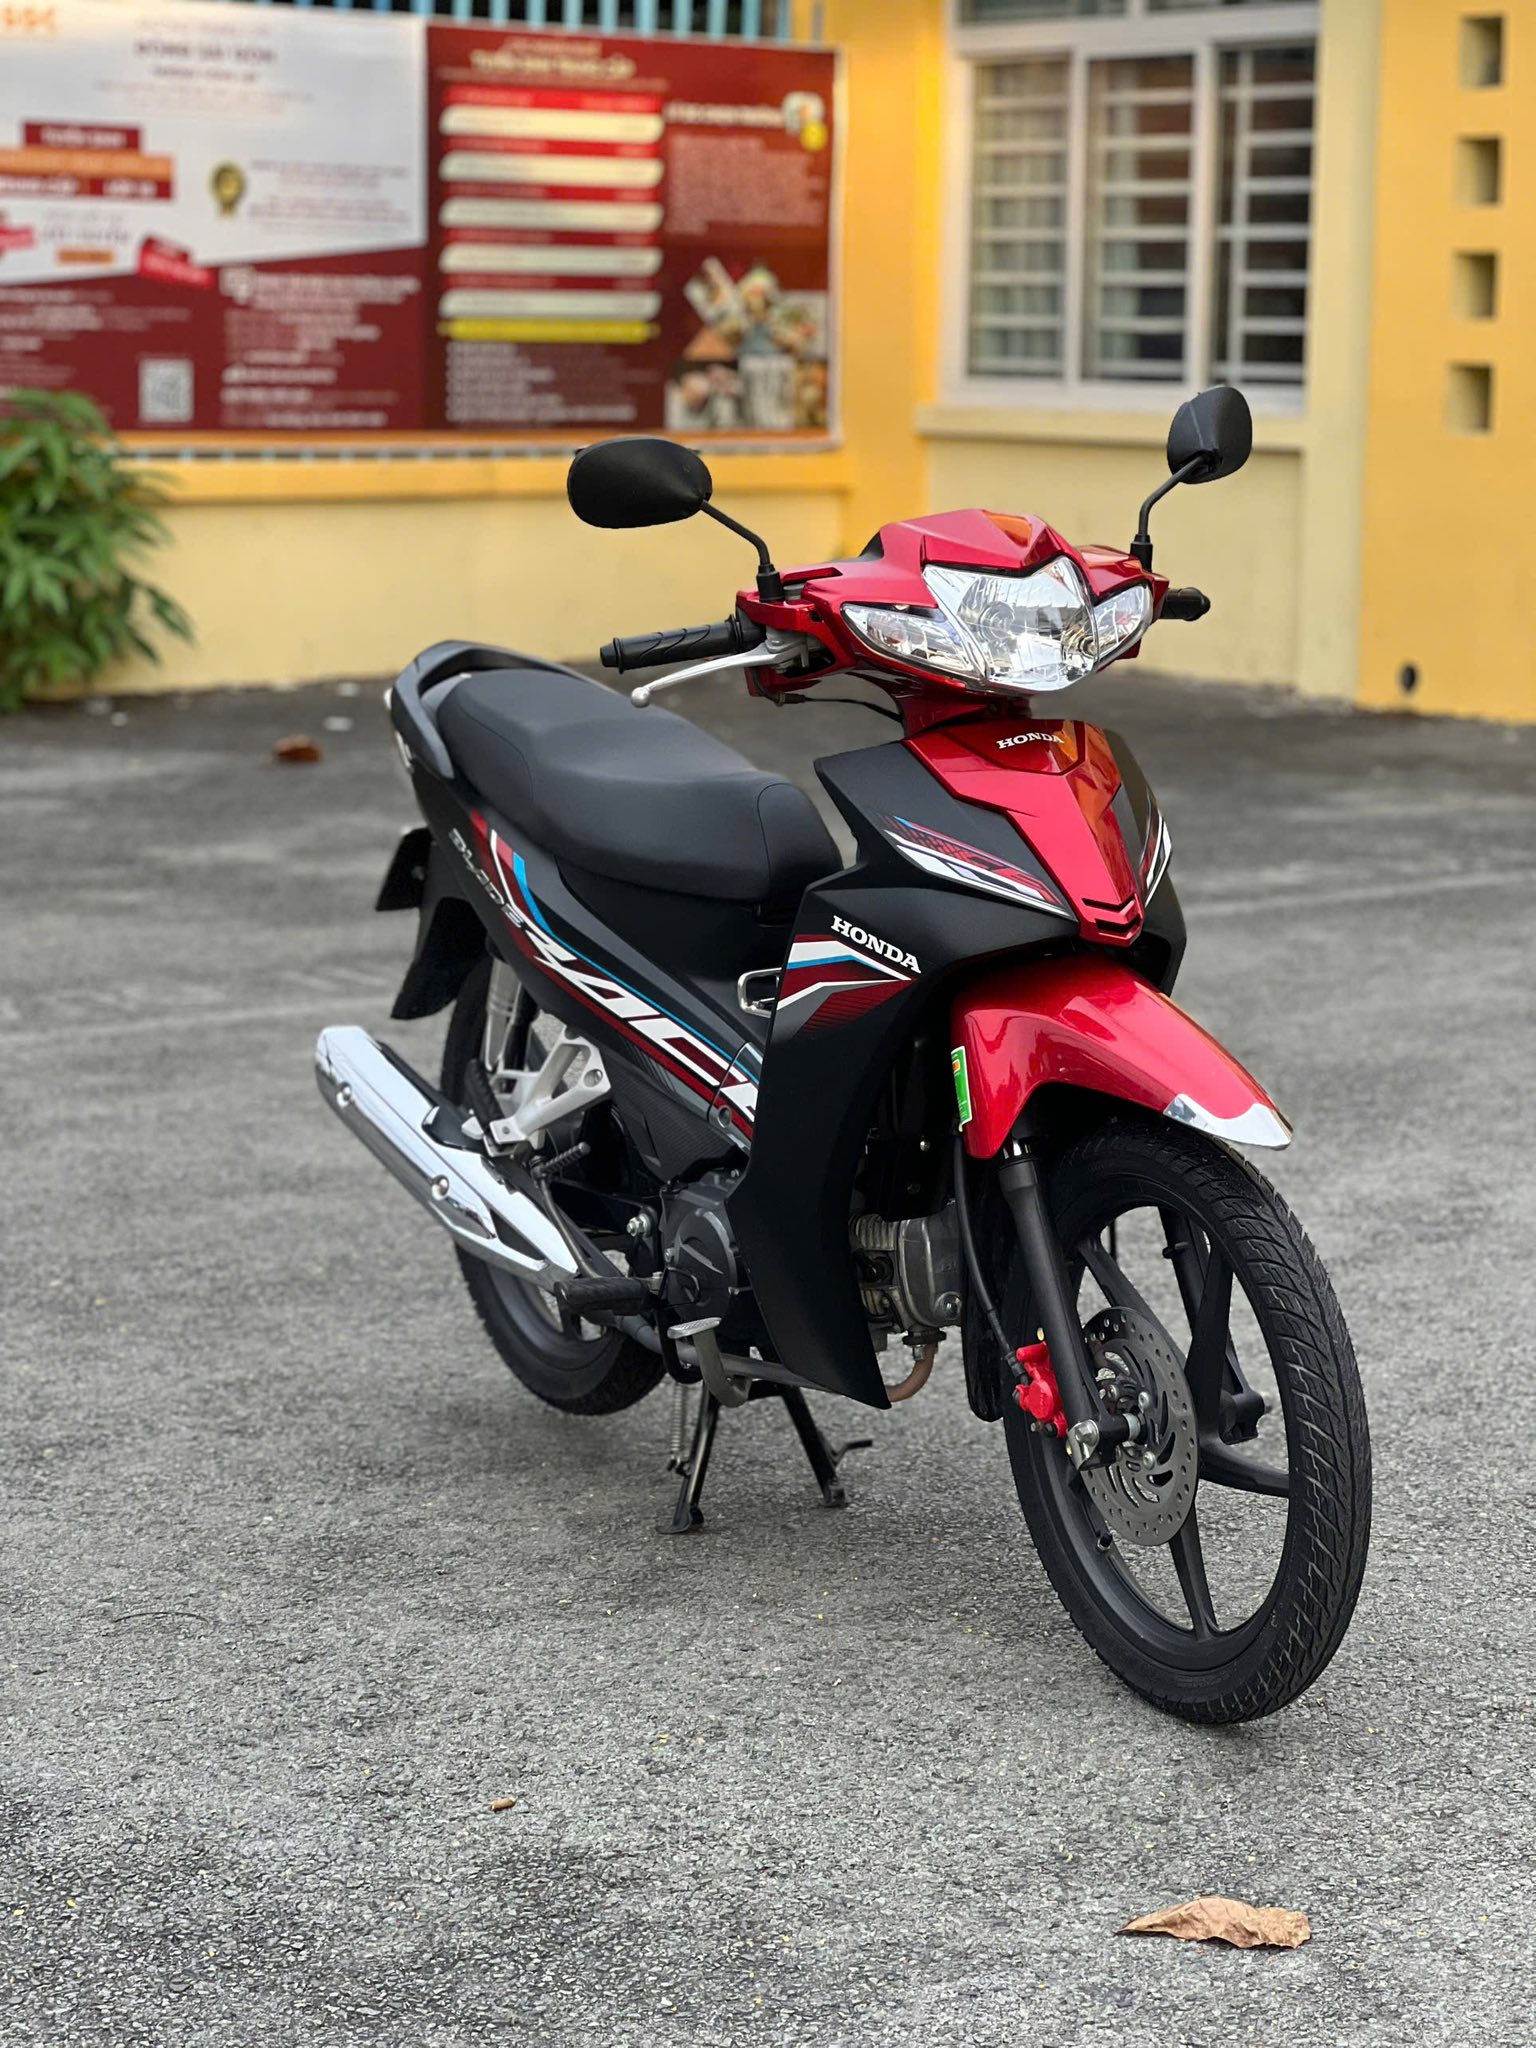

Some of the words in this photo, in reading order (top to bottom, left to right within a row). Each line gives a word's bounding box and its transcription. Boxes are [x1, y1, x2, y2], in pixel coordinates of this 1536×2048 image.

[996, 731, 1065, 750] HONDA
[448, 827, 526, 929] BLADE
[830, 914, 922, 975] HONDA
